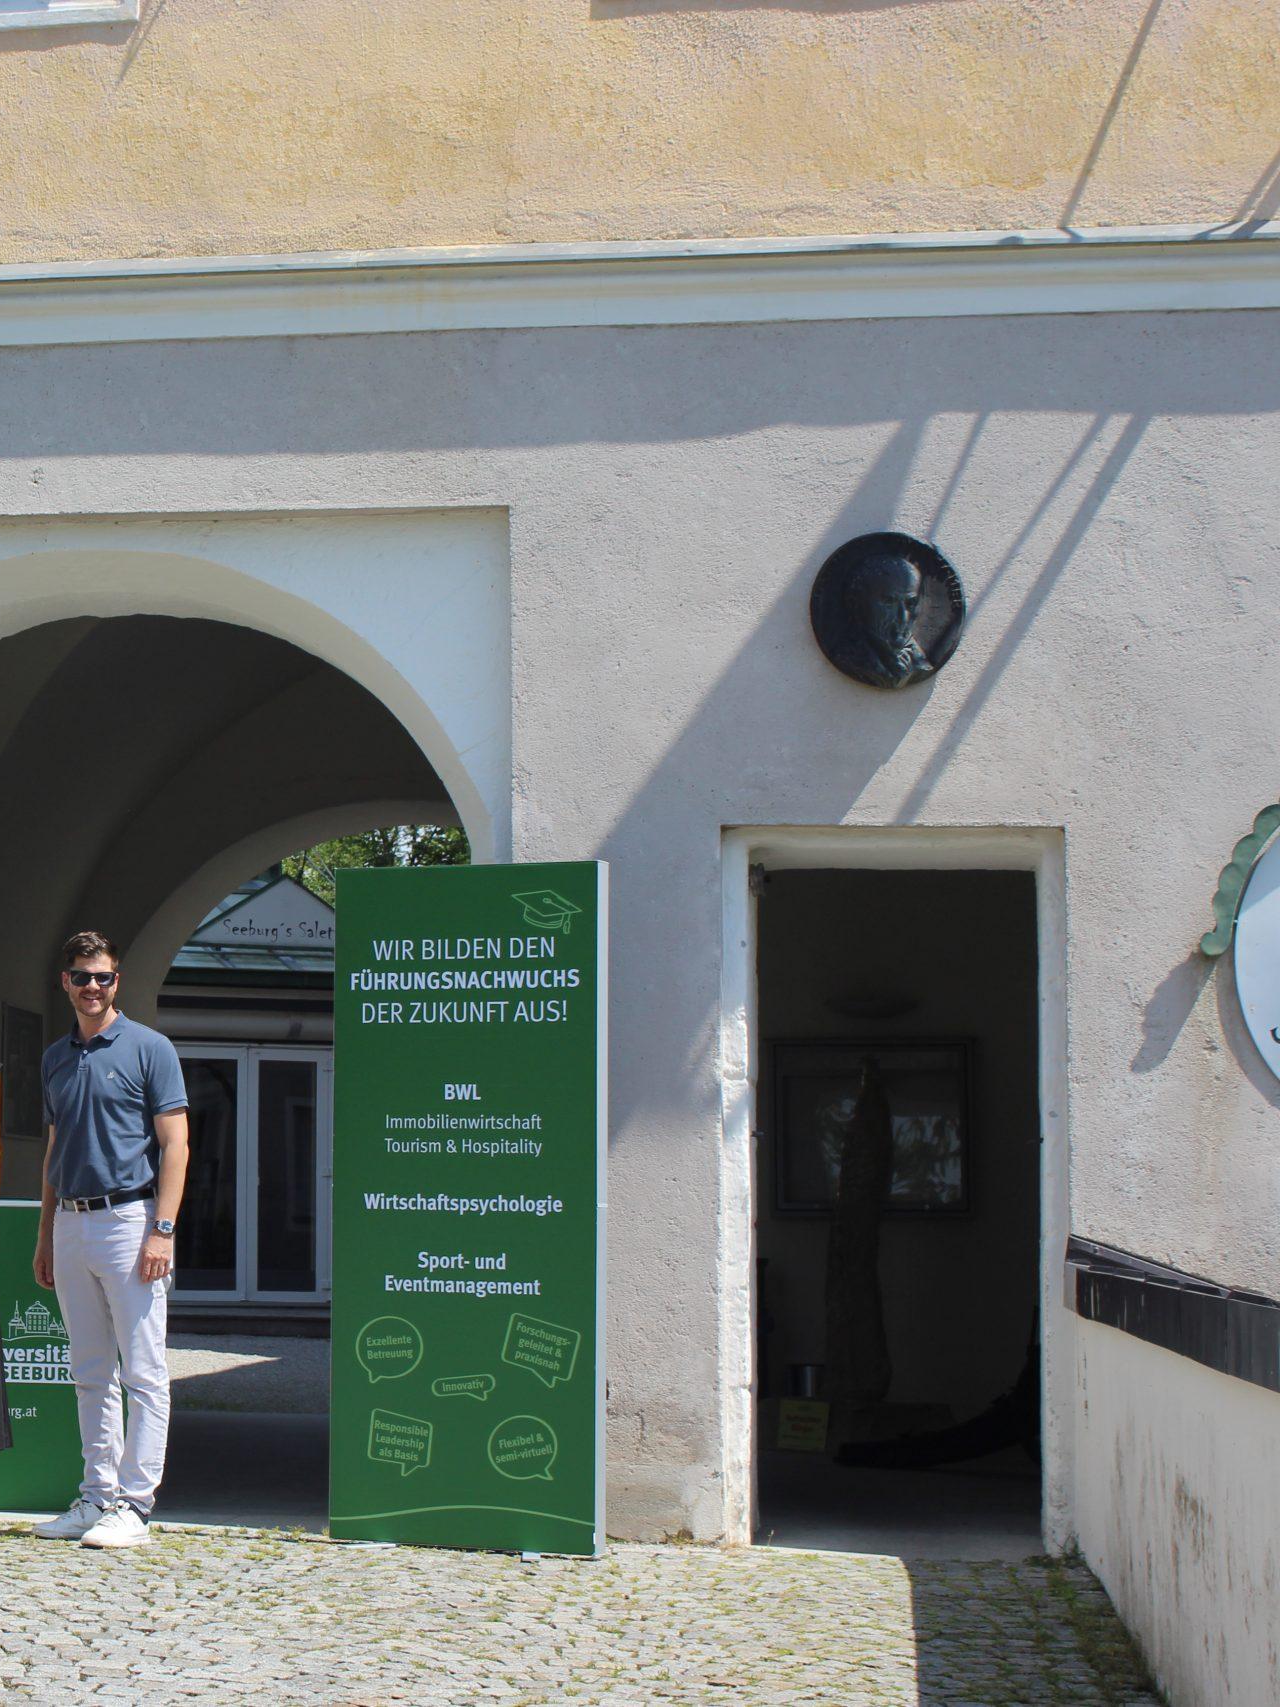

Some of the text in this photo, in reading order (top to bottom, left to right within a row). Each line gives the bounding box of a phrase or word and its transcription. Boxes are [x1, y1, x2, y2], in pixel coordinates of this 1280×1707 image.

[373, 936, 555, 961] WIR BILDEN DEN
[350, 968, 580, 991] FÜHRUNGSNACHWUCHS
[362, 1000, 568, 1024] DER ZUKUNFT AUS!
[444, 1084, 481, 1100] BWL
[385, 1114, 542, 1130] Immobilienwirtschaft
[385, 1138, 542, 1157] Tourism & Hospitality
[364, 1193, 563, 1216] Wirtschaftspsychologie
[418, 1251, 506, 1272] Sport- und
[385, 1275, 541, 1297] Eventmanagement
[366, 1335, 412, 1347] Exzellente
[516, 1322, 571, 1346] Forschungs-
[367, 1348, 413, 1360] Betreuung
[518, 1338, 562, 1358] geleitet &
[515, 1350, 560, 1371] praxisnah
[3, 1366, 76, 1381] SEEBUR
[442, 1379, 484, 1392] Innovativ
[374, 1420, 429, 1437] Responsible
[375, 1433, 425, 1451] Leadership
[498, 1433, 544, 1449] Flexibel &
[379, 1447, 419, 1462] als Basis
[495, 1445, 553, 1463] semi-virtuell
